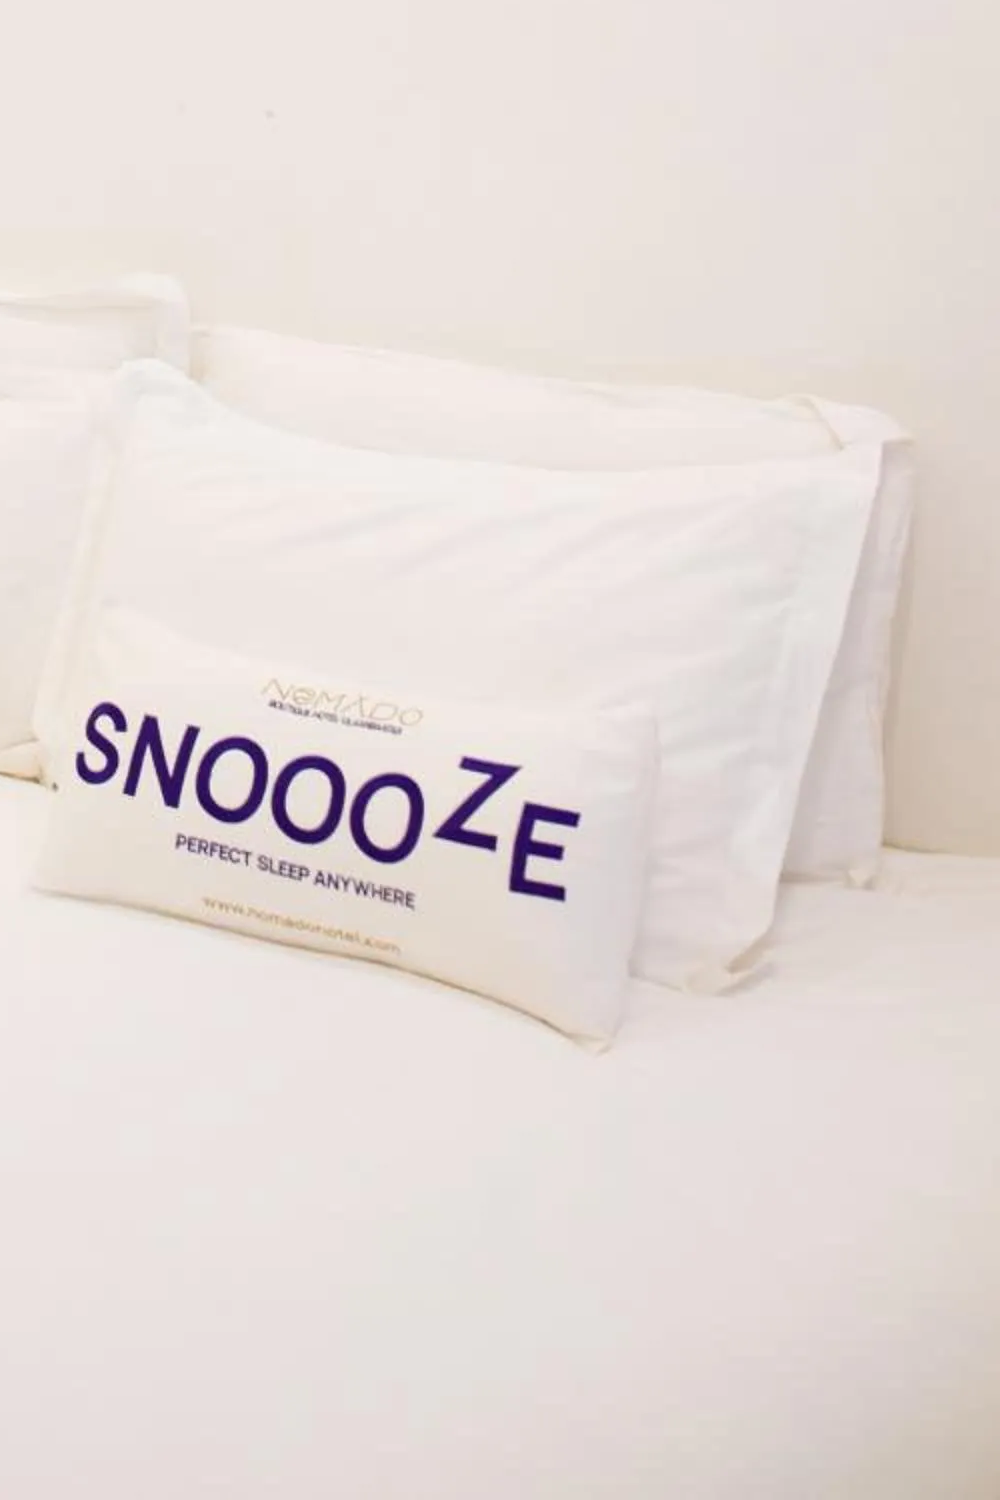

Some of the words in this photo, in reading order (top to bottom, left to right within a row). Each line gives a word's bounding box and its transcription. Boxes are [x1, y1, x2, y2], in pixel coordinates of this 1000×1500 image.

[75, 700, 582, 903] SNOOOZE
[175, 832, 252, 867] PERFECT
[257, 854, 311, 881] SLEEP
[313, 869, 417, 910] ANYWHERE
